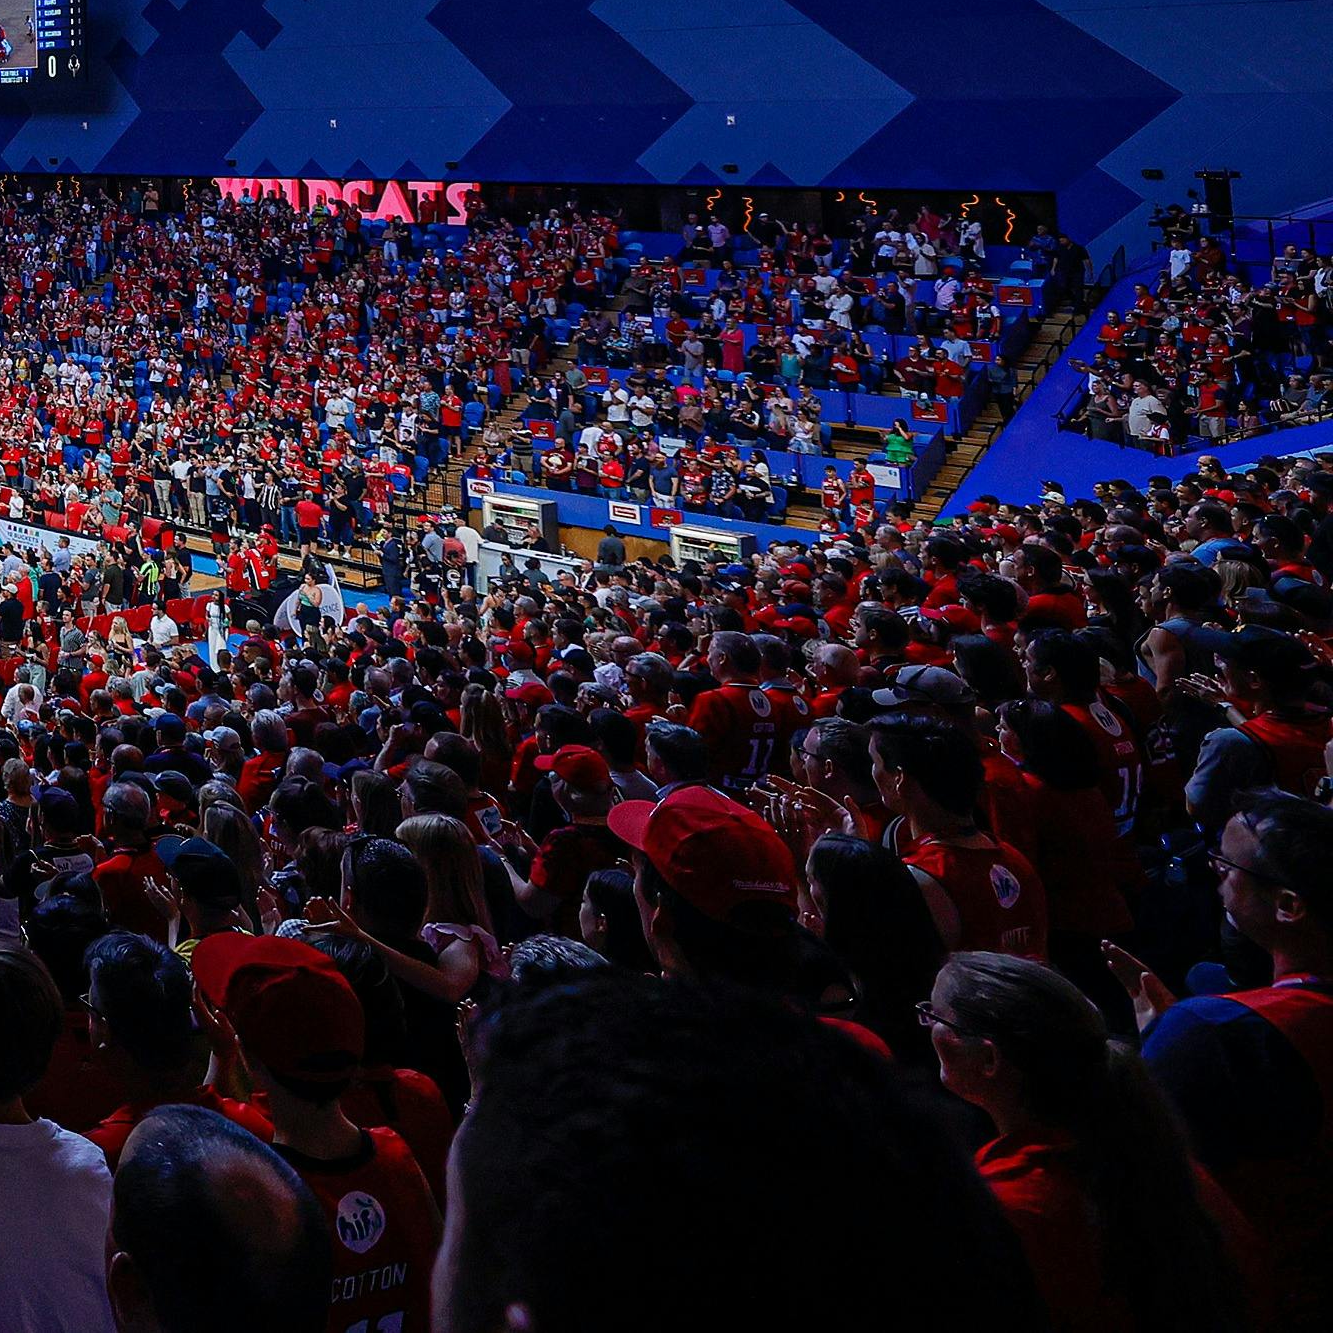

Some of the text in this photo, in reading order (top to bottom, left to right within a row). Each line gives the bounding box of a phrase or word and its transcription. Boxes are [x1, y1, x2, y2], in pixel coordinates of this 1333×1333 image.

[48, 55, 57, 78] 0
[337, 1207, 372, 1242] hif
[331, 1262, 408, 1304] COTTON
